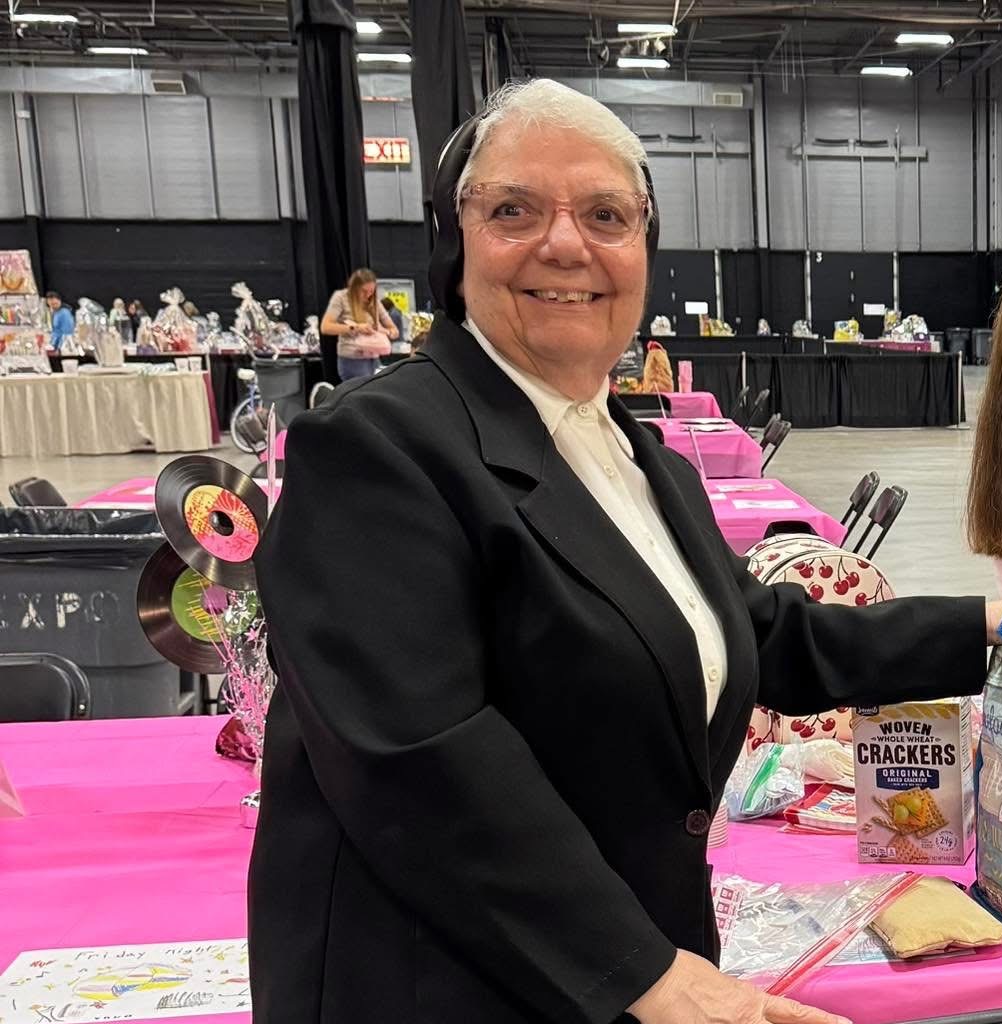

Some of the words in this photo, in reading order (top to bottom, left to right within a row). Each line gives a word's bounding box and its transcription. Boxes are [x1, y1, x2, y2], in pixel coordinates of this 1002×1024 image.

[0, 591, 119, 628] XPO
[879, 721, 932, 736] WOVEN
[876, 735, 904, 743] WHOLE
[907, 735, 935, 743] WHEAT
[857, 742, 956, 766] CRACKERS
[882, 768, 932, 778] ORIGINAL
